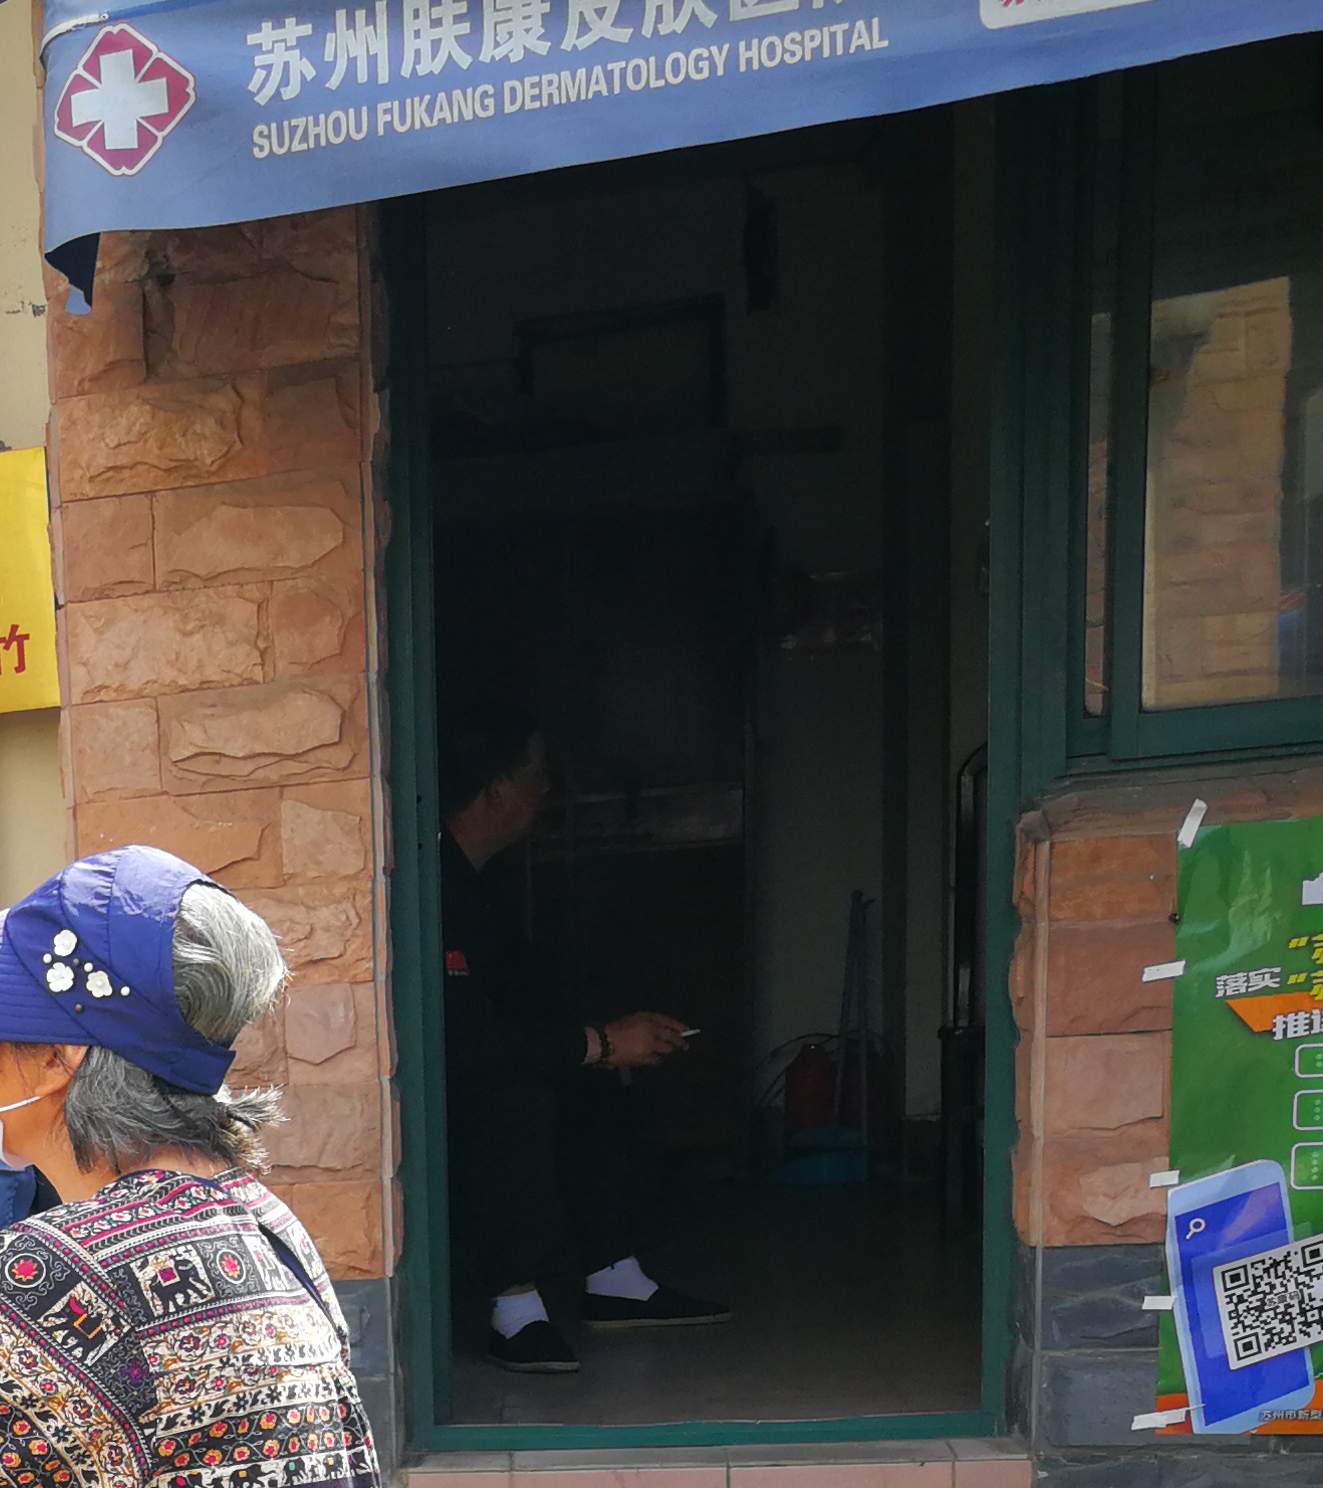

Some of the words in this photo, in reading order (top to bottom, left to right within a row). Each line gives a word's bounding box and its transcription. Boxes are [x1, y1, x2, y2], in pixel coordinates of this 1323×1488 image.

[247, 0, 855, 106] 苏州肤康皮
[252, 105, 368, 159] SUZHOU
[376, 84, 496, 137] FUKANG
[503, 43, 731, 115] DERMATOLOGY
[738, 17, 890, 72] HOSPITAL
[1215, 966, 1282, 998] 落实
